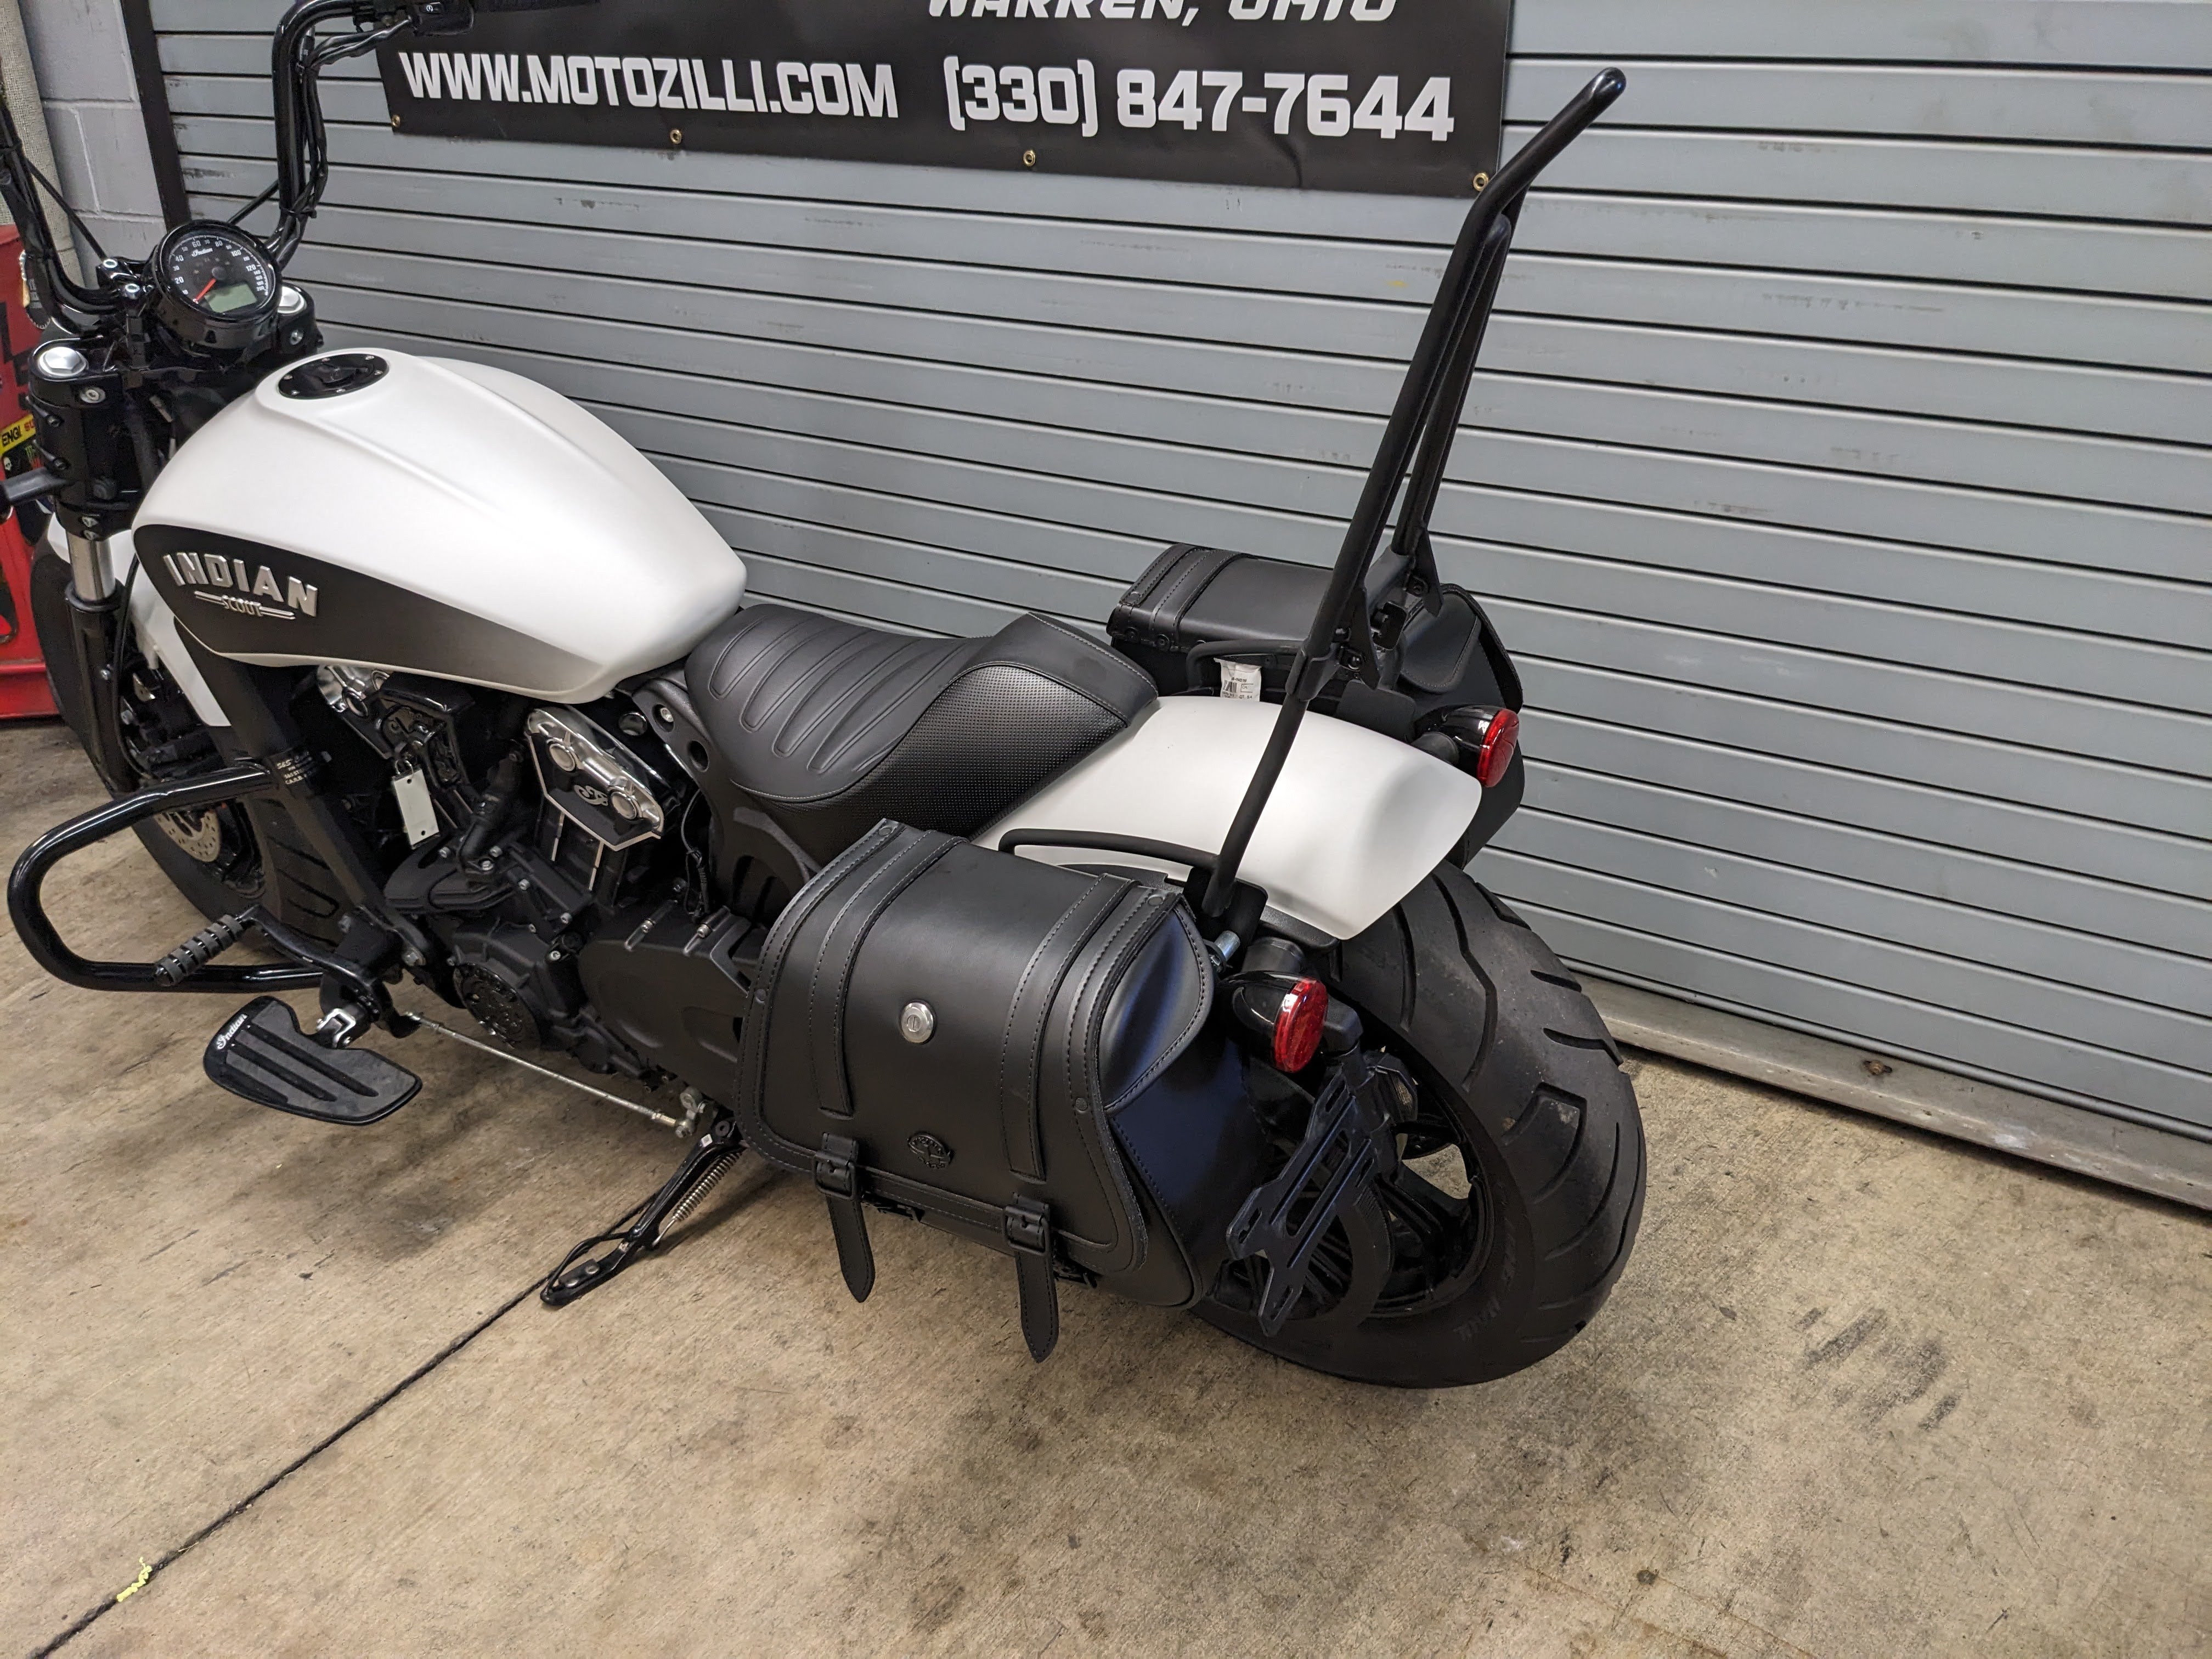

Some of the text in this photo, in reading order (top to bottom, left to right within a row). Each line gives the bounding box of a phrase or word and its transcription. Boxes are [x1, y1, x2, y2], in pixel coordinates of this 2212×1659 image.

[398, 52, 1454, 142] WWW.MOTOZILLI.COM (330) 847-7644
[191, 247, 213, 257] Indian
[163, 552, 318, 618] INDIAN
[221, 594, 263, 617] SCOUT
[216, 1013, 248, 1049] Indian
